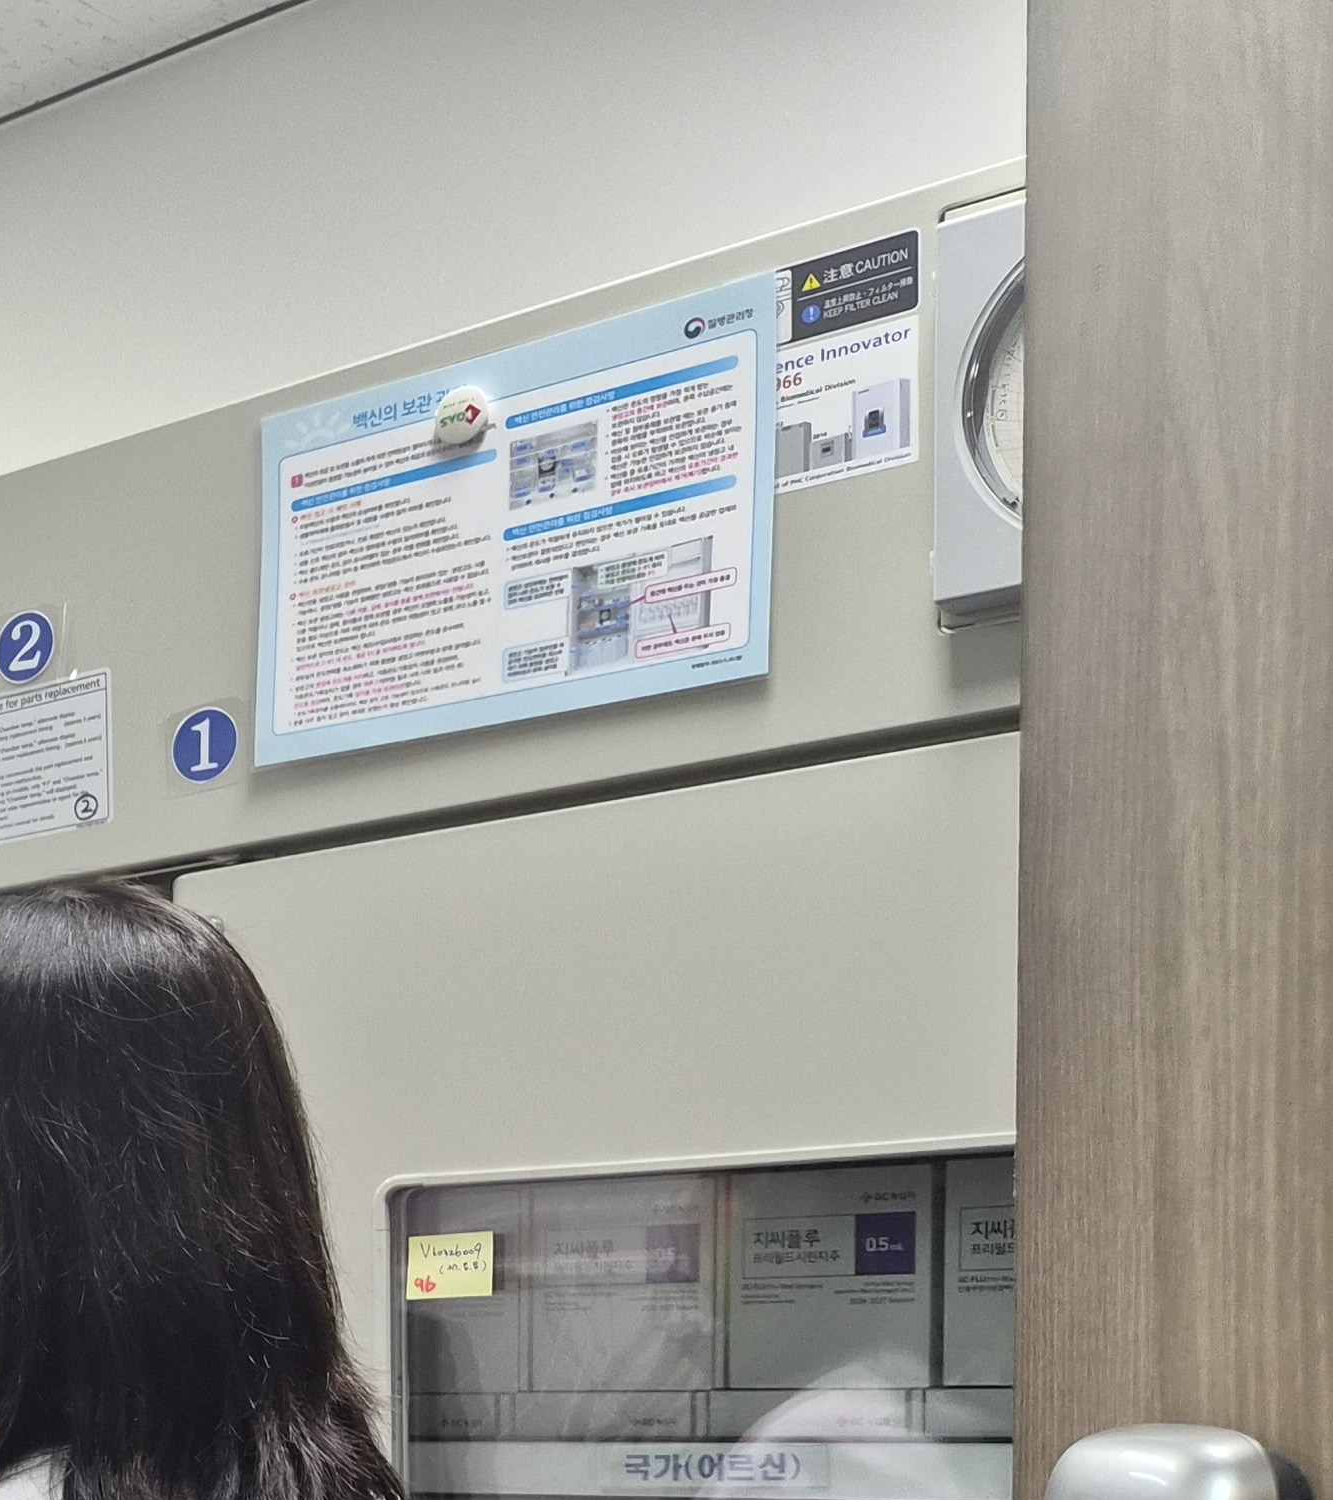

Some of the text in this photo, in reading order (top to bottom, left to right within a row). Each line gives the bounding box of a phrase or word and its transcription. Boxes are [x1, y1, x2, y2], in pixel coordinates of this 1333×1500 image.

[855, 248, 909, 275] CAUTION
[707, 308, 754, 329] 질병관리청
[823, 291, 899, 319] KEEP FILTER CLEAN
[820, 327, 911, 361] Innovator
[825, 378, 856, 393] Division
[352, 394, 433, 430] 백신의 보관
[7, 619, 41, 672] 2
[5, 698, 19, 710] for
[20, 693, 44, 709] parts
[44, 678, 101, 701] replacement
[190, 717, 218, 772] 1
[752, 1229, 821, 1249] 지씨플루
[623, 1452, 802, 1483] 국가(어르신)
